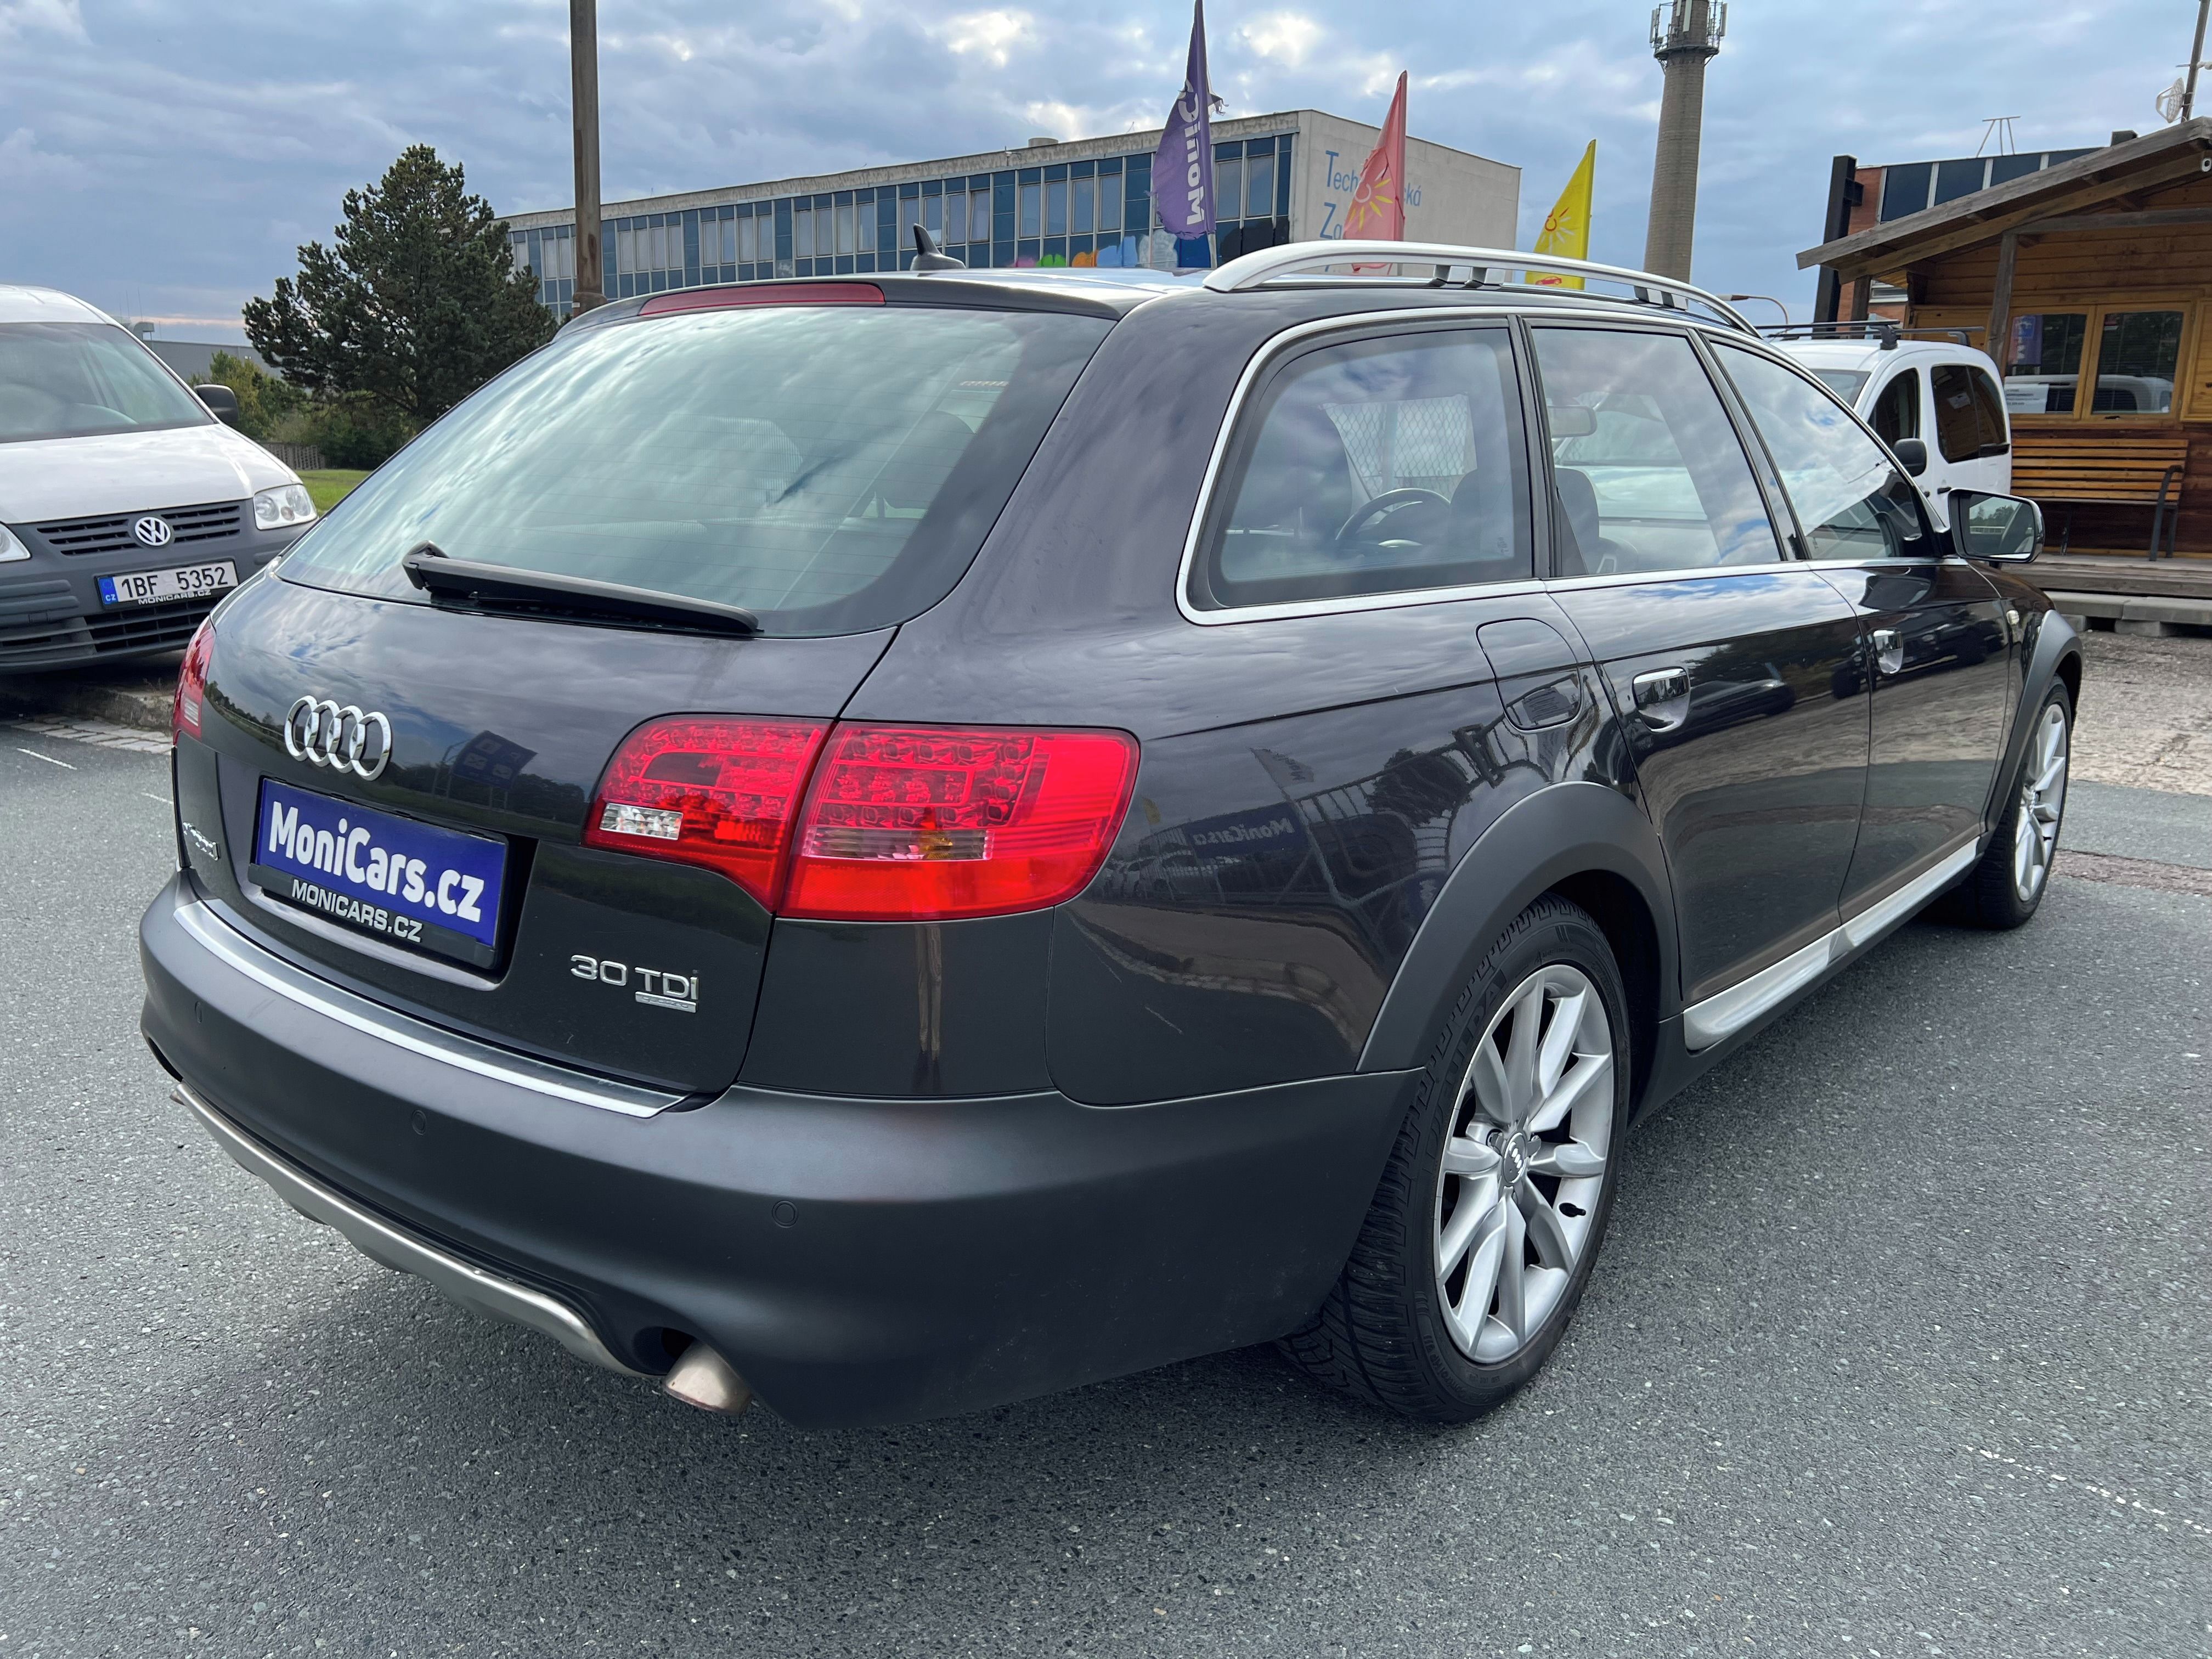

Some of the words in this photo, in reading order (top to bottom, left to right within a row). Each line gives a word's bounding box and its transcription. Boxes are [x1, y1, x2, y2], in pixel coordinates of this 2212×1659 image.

[105, 593, 116, 602] CZ
[121, 575, 159, 598] 1BF
[176, 567, 228, 590] 5352
[268, 800, 484, 923] MoniCars.cz
[291, 879, 423, 943] MONICARS.CZ
[570, 955, 628, 986] 30
